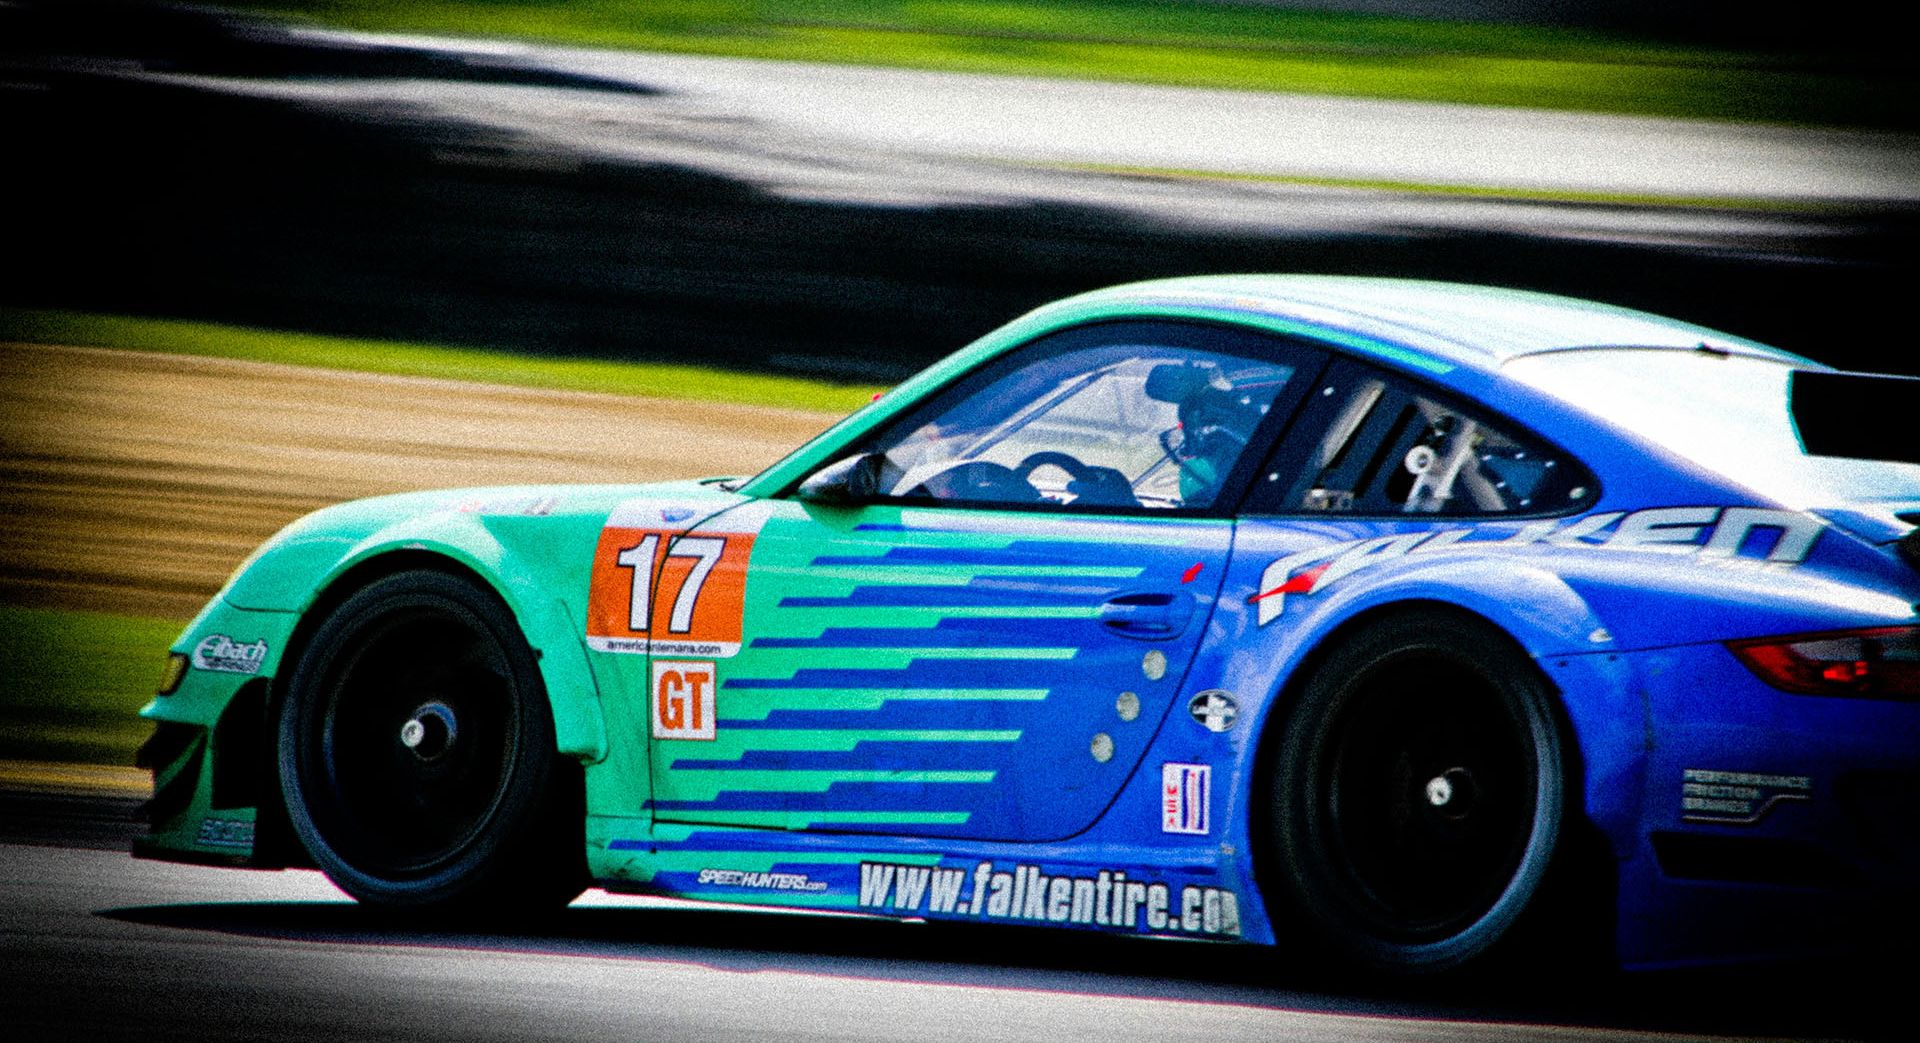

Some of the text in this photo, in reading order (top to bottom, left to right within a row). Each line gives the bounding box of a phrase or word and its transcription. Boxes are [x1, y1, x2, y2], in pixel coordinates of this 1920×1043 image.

[616, 533, 728, 635] 17
[1257, 506, 1823, 627] FALKEN
[658, 669, 710, 731] GT
